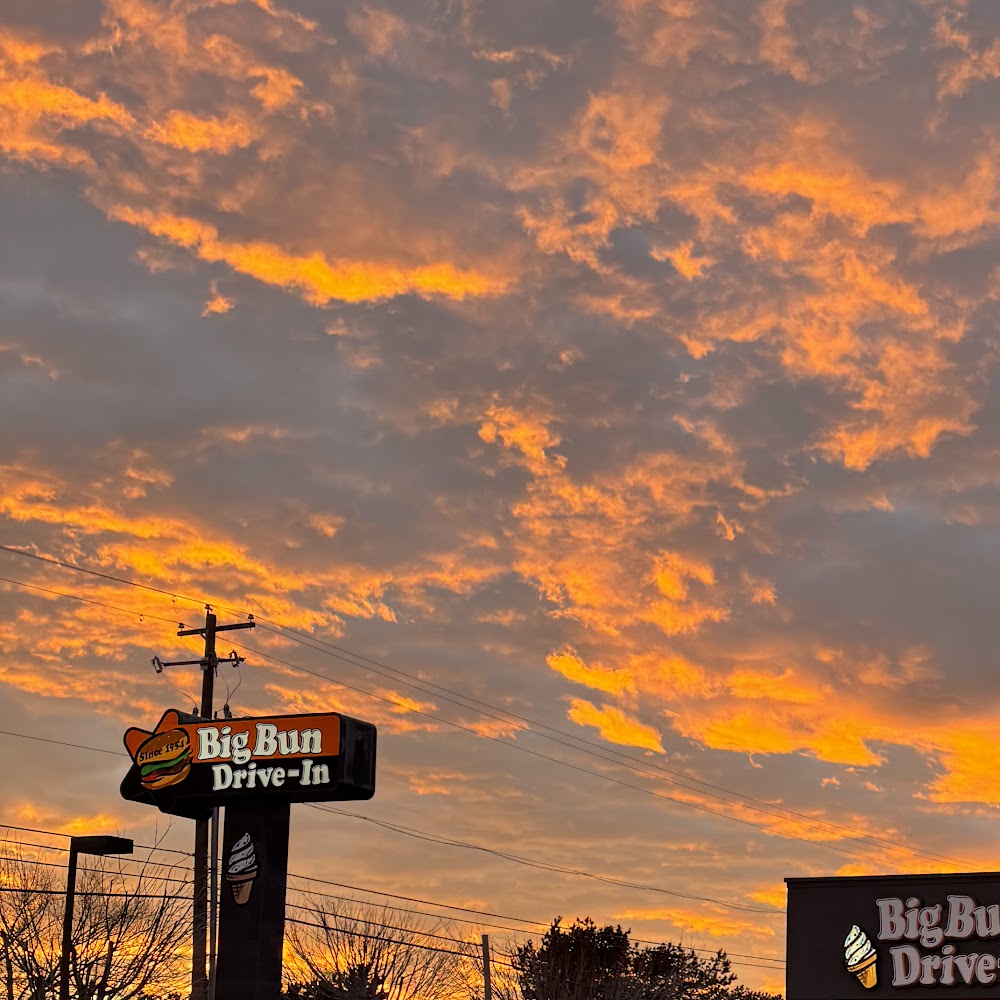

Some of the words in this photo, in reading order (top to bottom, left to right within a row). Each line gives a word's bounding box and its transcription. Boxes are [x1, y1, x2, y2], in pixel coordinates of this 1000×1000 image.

[139, 749, 163, 762] Since
[165, 740, 184, 753] 1954
[197, 726, 250, 763] Big
[253, 723, 322, 756] Bun
[212, 759, 330, 791] Drive-In
[875, 897, 943, 948] Big
